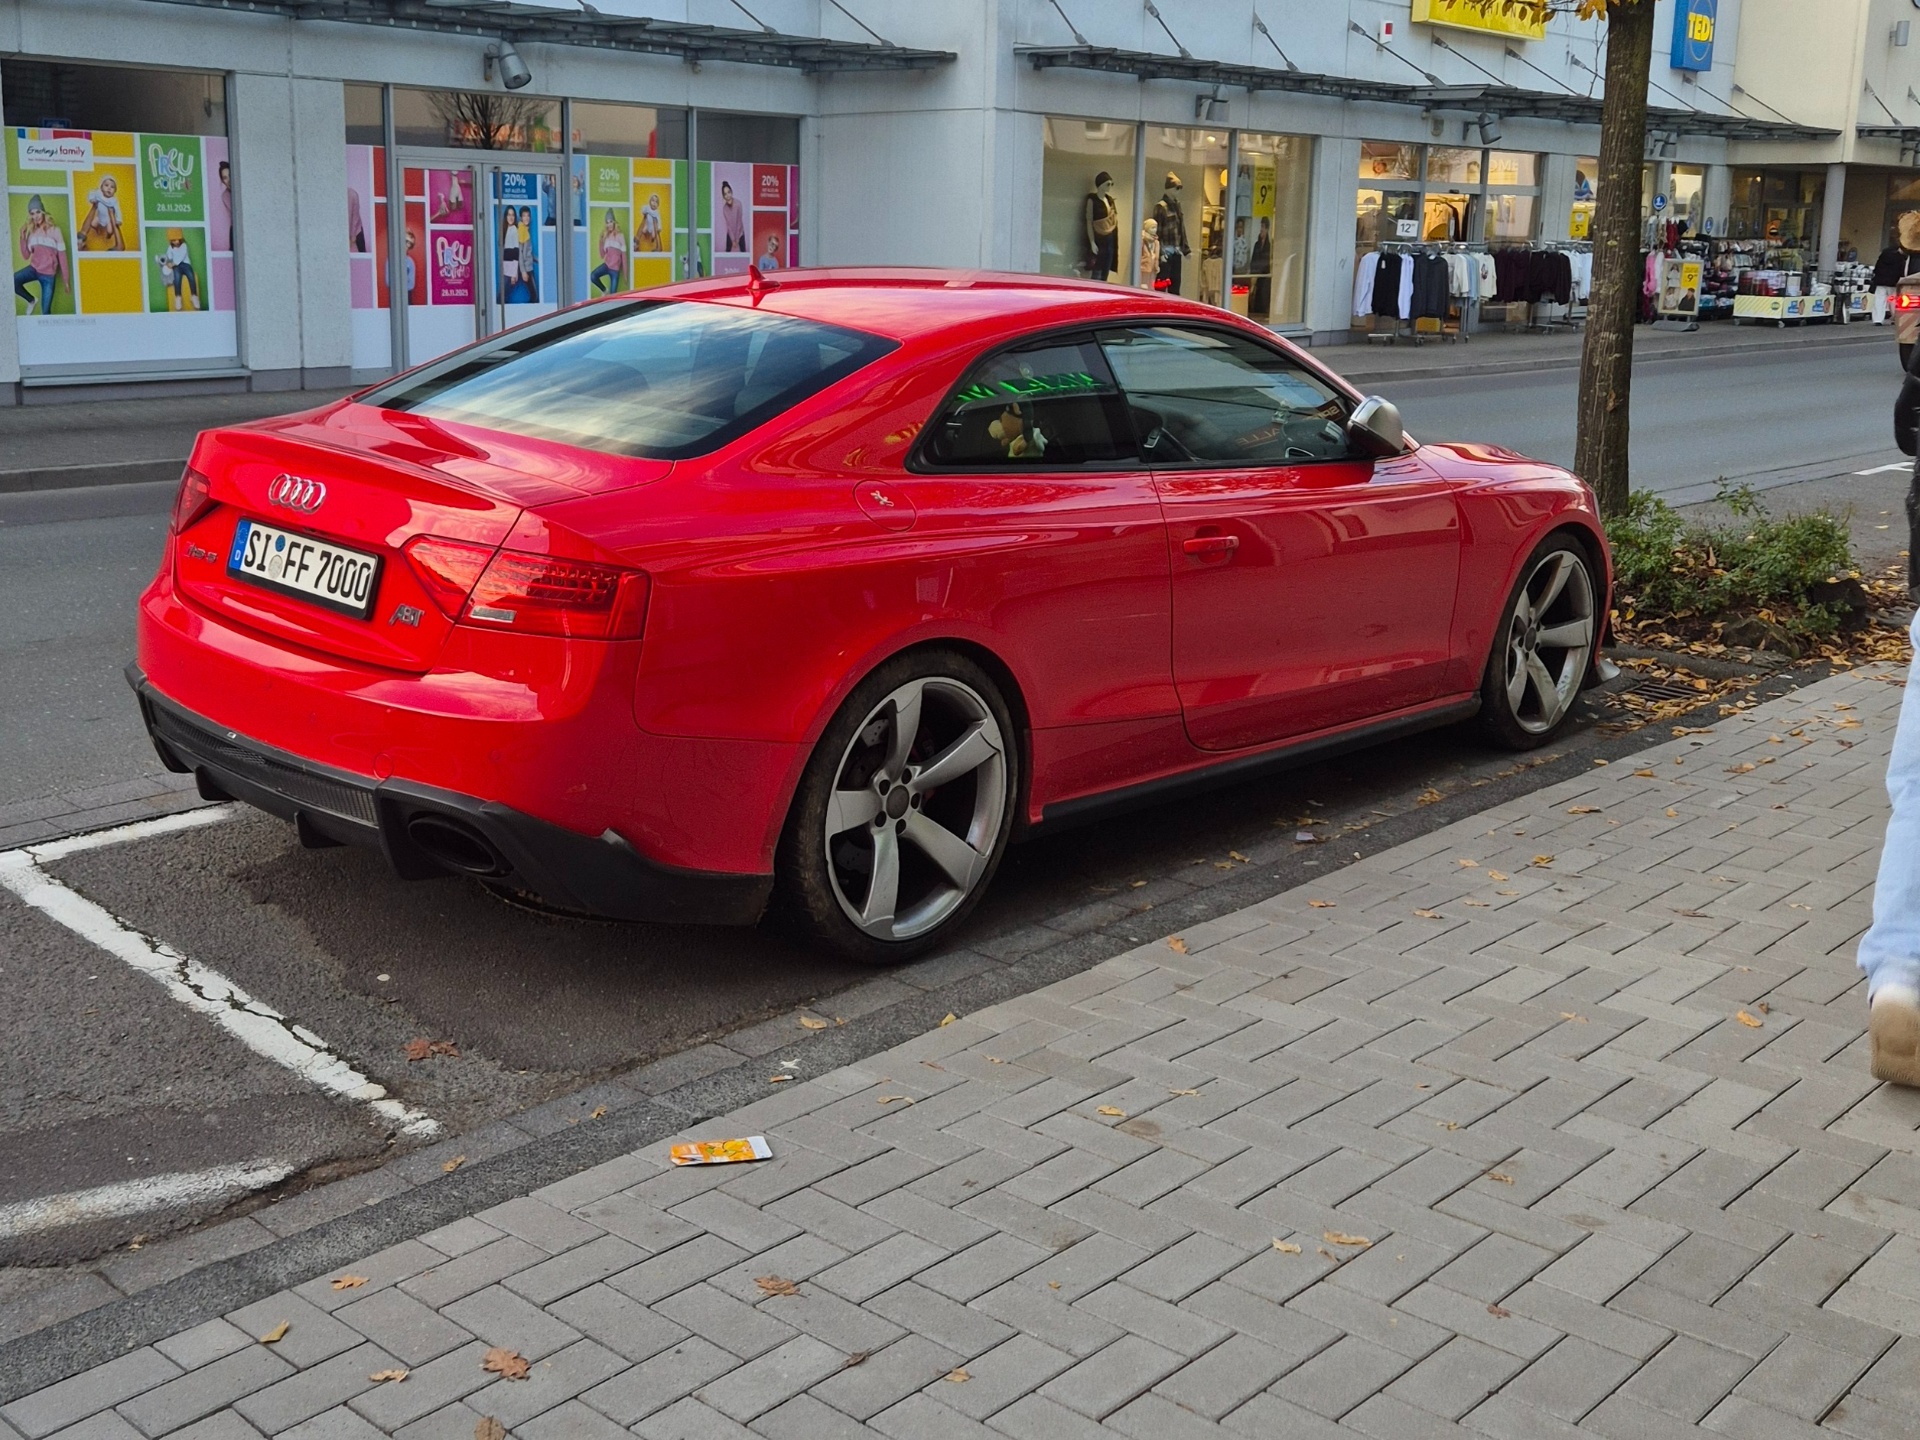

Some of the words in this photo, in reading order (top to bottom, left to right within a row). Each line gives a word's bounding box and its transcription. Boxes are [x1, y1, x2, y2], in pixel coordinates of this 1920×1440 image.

[1688, 12, 1714, 42] TEDi
[59, 145, 86, 158] family
[504, 173, 527, 187] 20%
[600, 168, 620, 180] 20%
[761, 175, 779, 187] 20%
[156, 203, 191, 212] 28.11.2025
[244, 530, 272, 572] SI
[282, 542, 315, 583] FF
[314, 551, 371, 602] 7000
[388, 603, 425, 627] ABT
